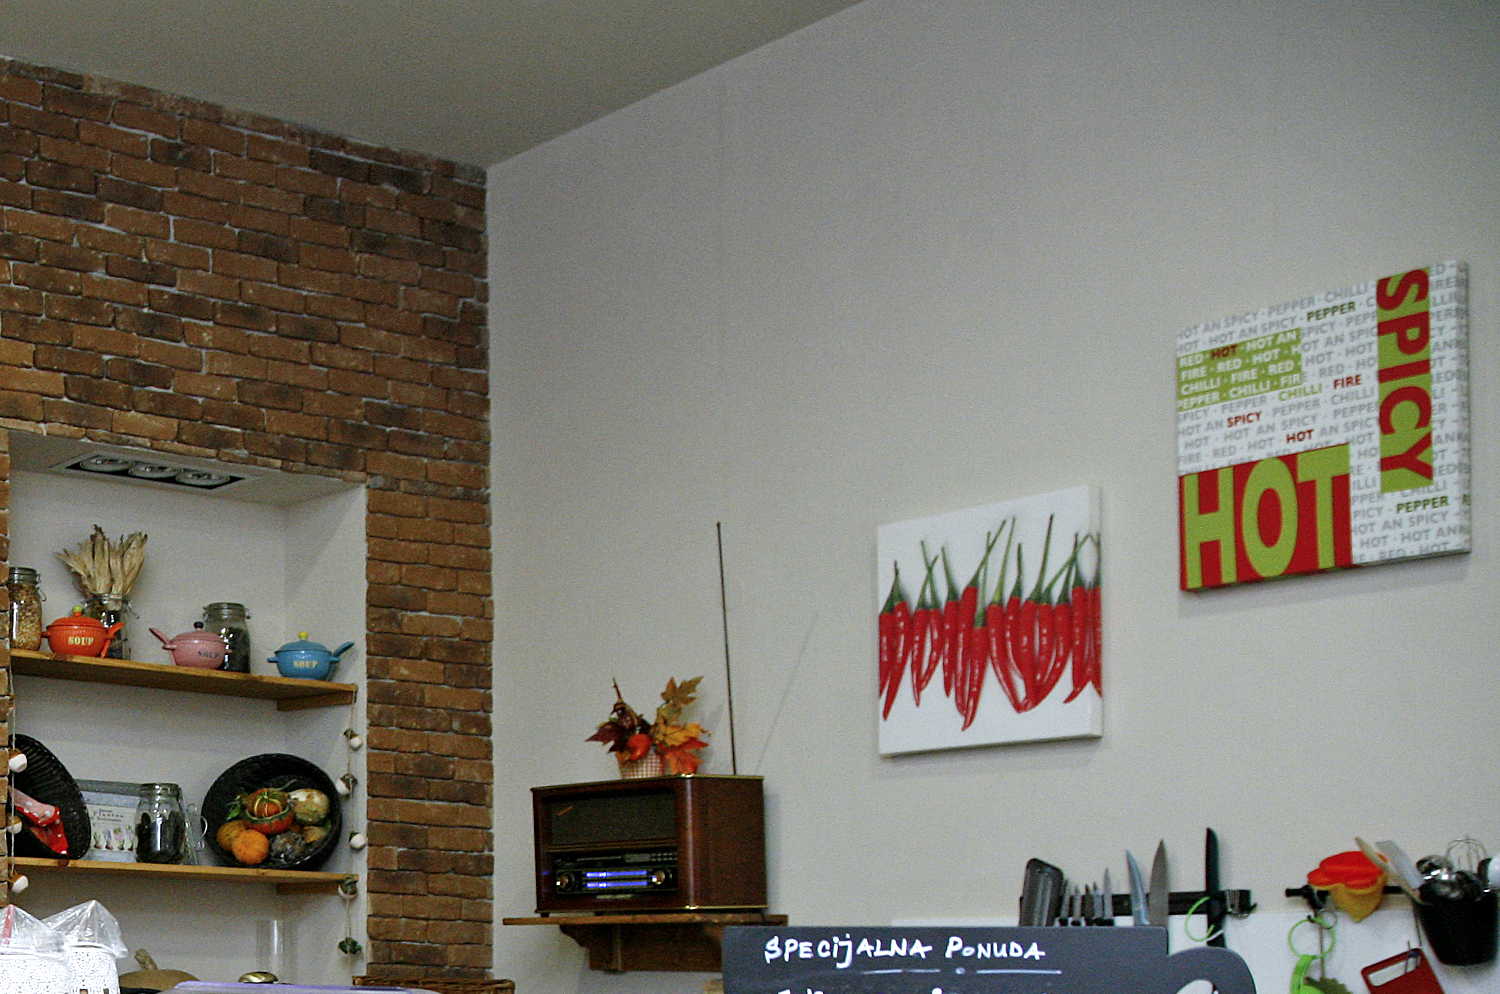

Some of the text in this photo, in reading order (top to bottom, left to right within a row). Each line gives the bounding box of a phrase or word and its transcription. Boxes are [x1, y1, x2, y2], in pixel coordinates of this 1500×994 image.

[1307, 302, 1356, 323] PEPPER
[1211, 344, 1238, 361] HOT
[1333, 374, 1363, 390] FIRE
[1376, 269, 1434, 482] SPICY
[1227, 411, 1263, 428] SPICY
[1286, 429, 1314, 444] HOT
[1396, 496, 1449, 514] PEPPER
[1183, 443, 1350, 590] HOT
[68, 635, 94, 646] SOUP
[946, 936, 1046, 961] PONUDA
